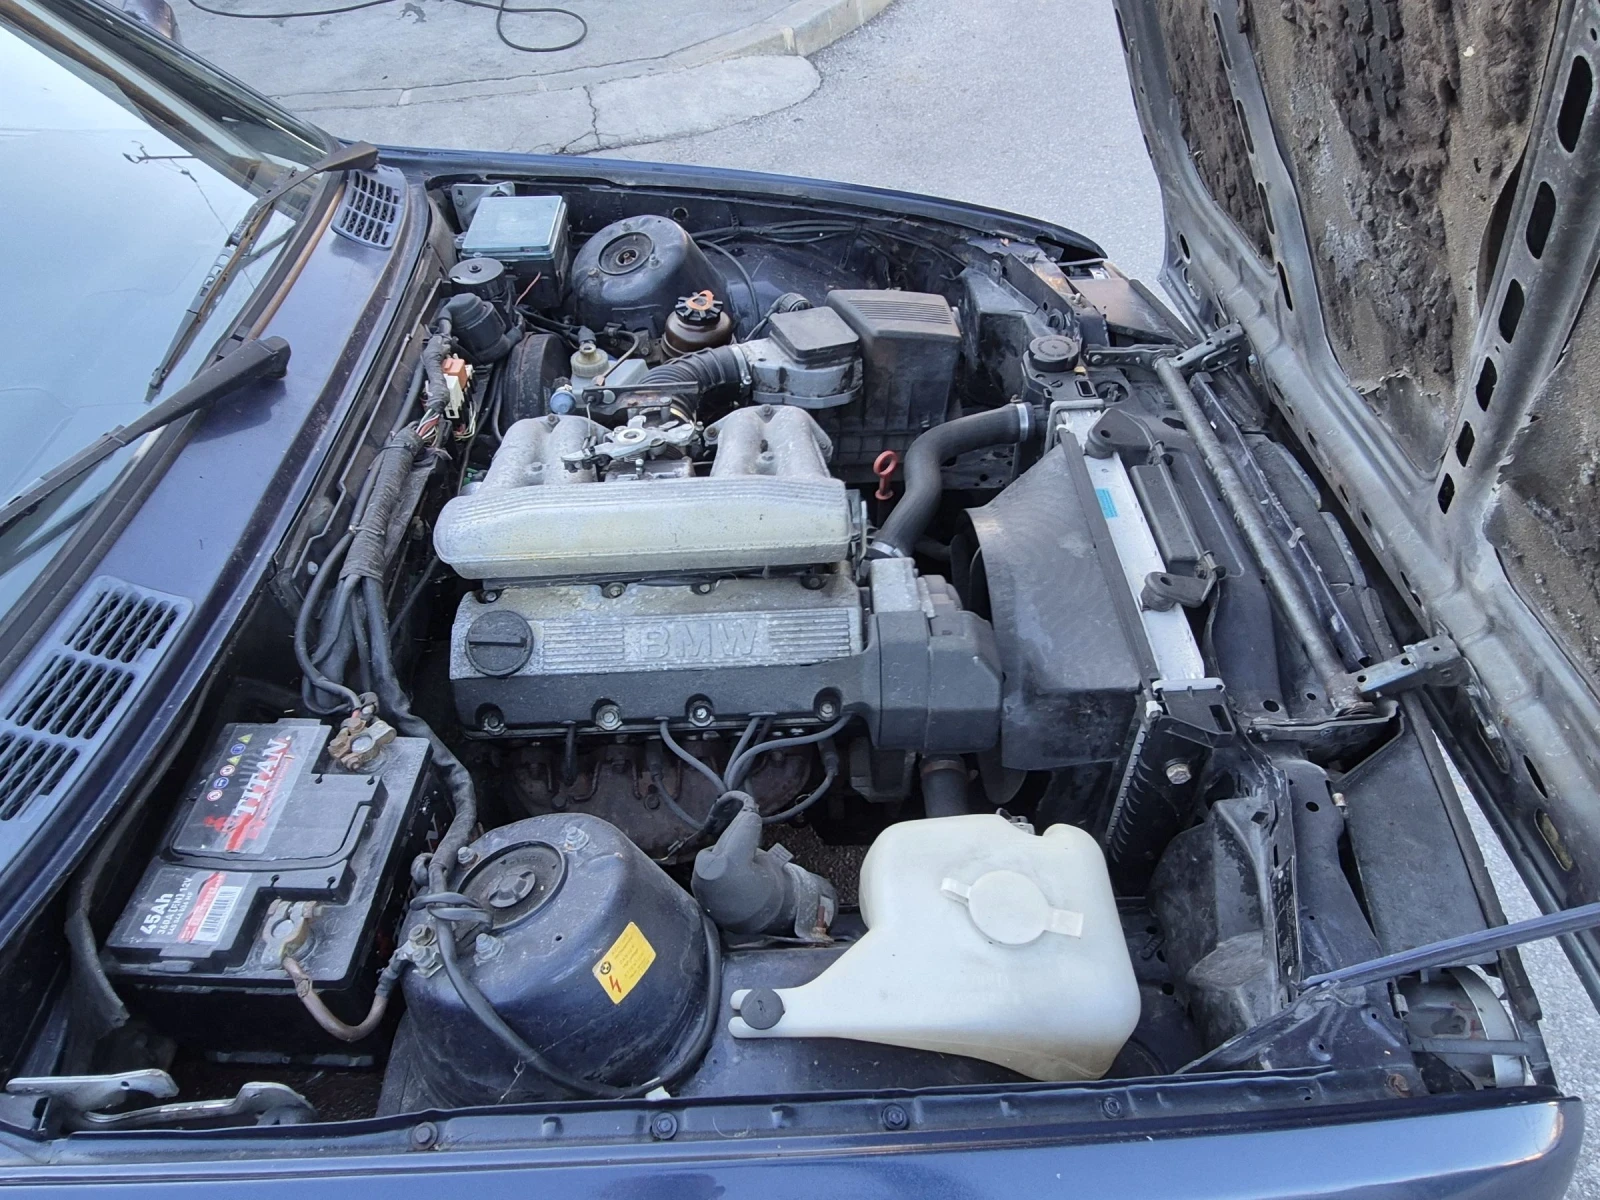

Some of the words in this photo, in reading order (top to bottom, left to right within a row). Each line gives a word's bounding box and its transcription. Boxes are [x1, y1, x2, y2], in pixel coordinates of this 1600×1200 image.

[640, 620, 758, 660] BMW
[140, 893, 174, 935] 45Ah
[157, 914, 174, 935] 360A
[180, 877, 193, 892] 12V
